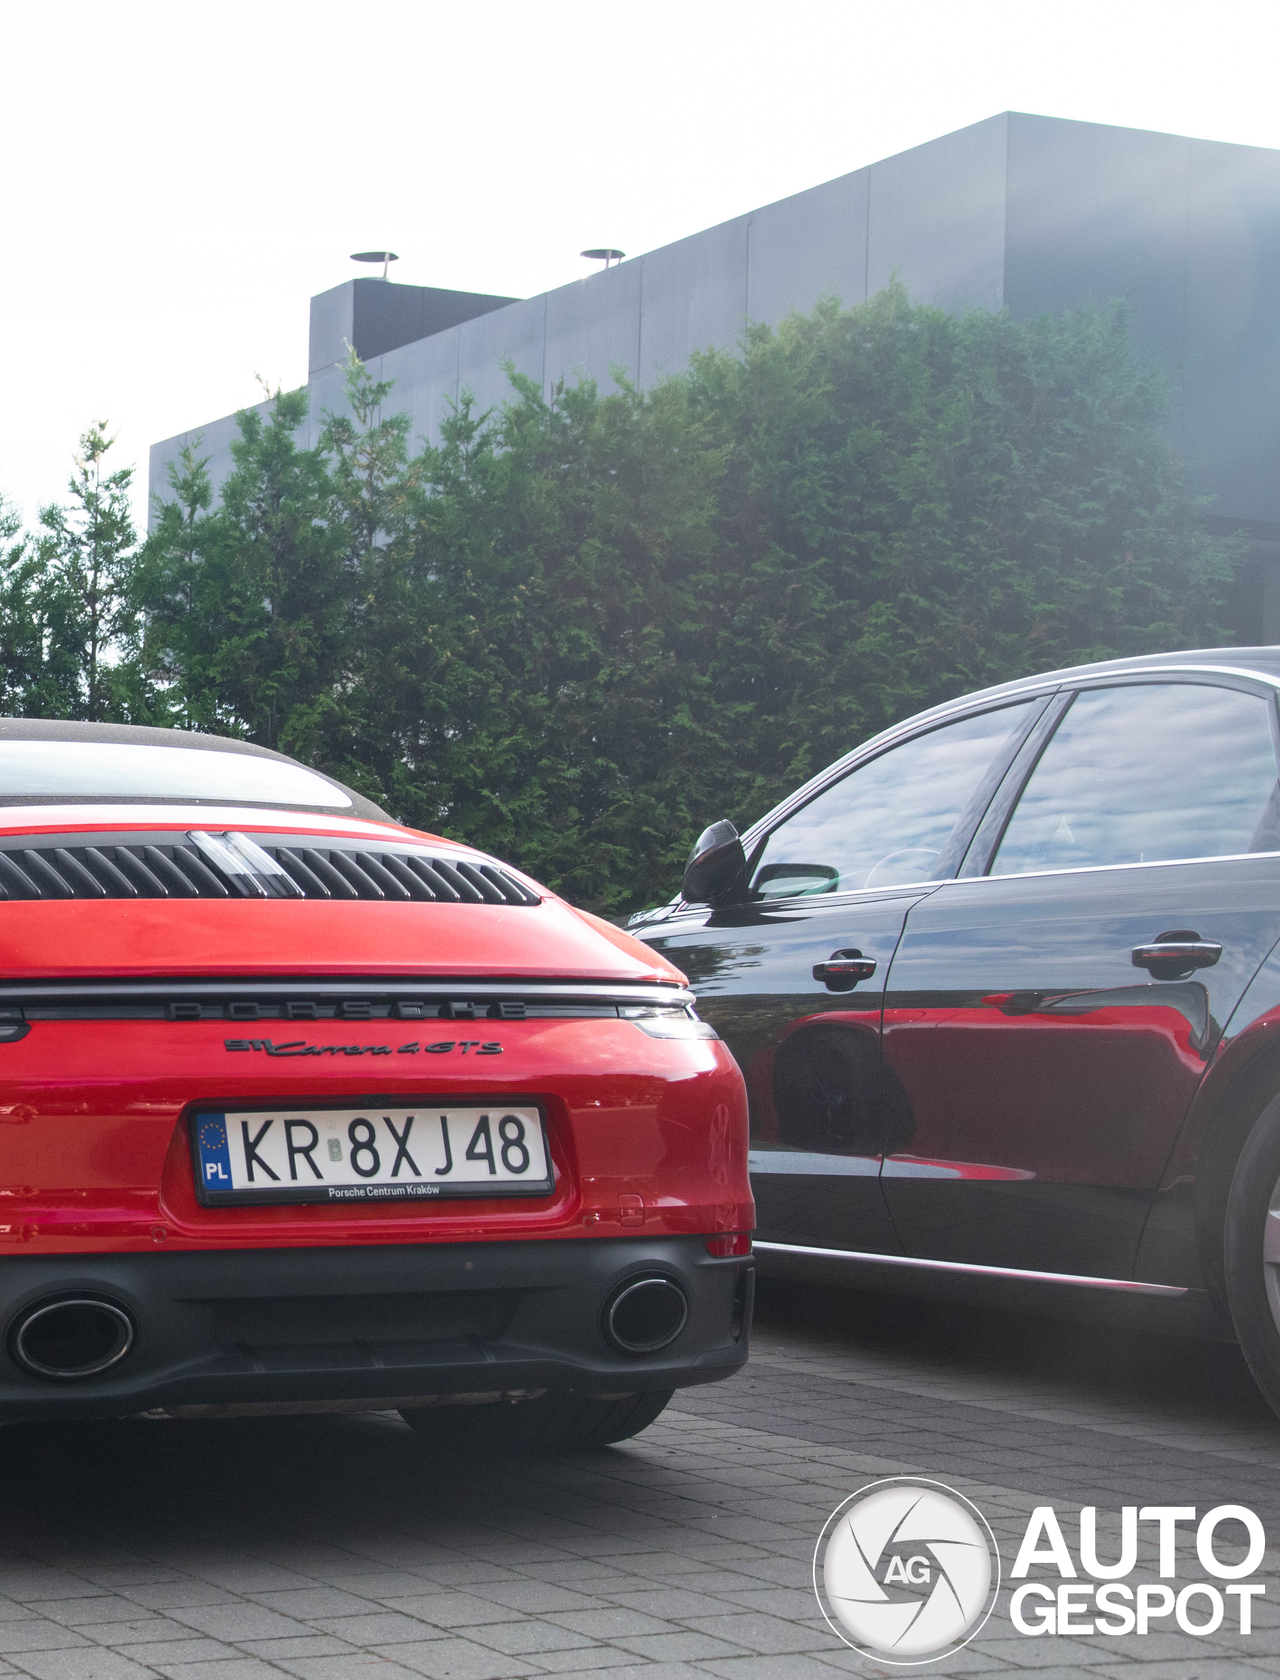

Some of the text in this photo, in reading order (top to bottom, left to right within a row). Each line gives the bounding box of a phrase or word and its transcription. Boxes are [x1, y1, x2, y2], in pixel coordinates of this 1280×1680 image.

[167, 1001, 527, 1021] PORSCHE
[224, 1038, 505, 1057] 911 Carrera 4 GTS
[240, 1114, 531, 1183] KR 8XJ48
[205, 1162, 229, 1180] PL
[328, 1184, 440, 1198] Porsche Centrum Kraków
